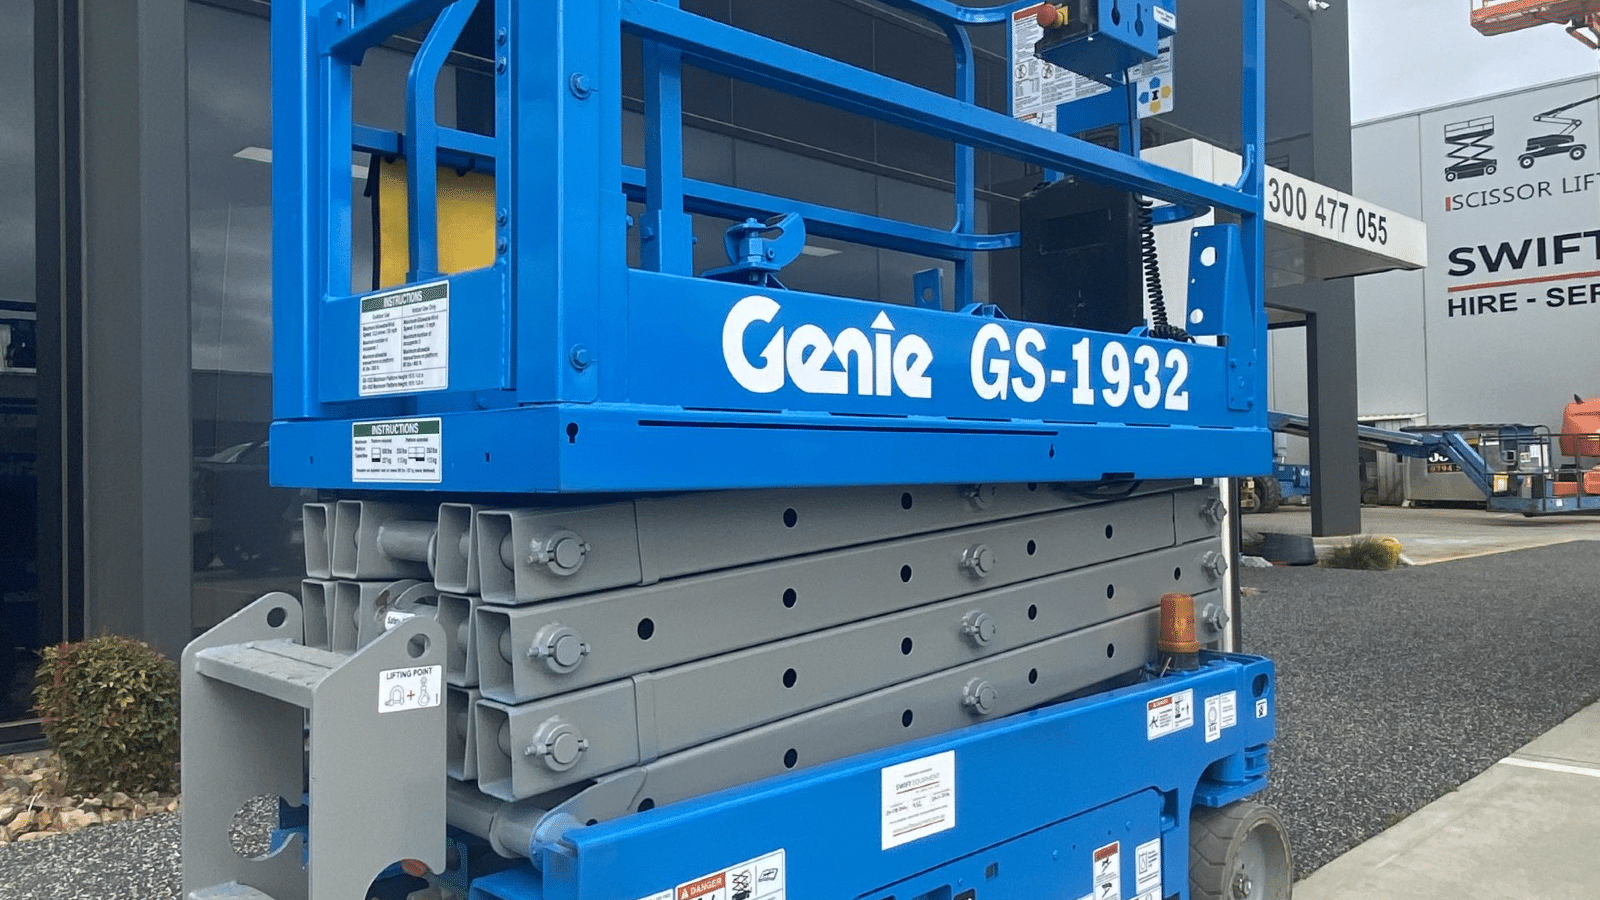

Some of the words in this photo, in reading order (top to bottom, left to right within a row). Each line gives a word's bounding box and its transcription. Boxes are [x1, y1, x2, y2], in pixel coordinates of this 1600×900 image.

[1452, 181, 1552, 211] SCISSOR
[1562, 172, 1600, 194] LIF
[1269, 177, 1307, 221] 300
[1315, 194, 1349, 233] 477
[1357, 207, 1387, 246] 055
[1447, 229, 1600, 277] SWIFT
[383, 290, 423, 308] INSTRUCTIONS
[1448, 292, 1518, 318] HIRE
[722, 295, 934, 399] Genie
[970, 322, 1189, 412] GS-1932
[371, 422, 419, 435] INSTRUCTIONS
[386, 669, 412, 680] LIFTING
[413, 667, 432, 677] POINT
[895, 780, 912, 791] SWIFT
[912, 772, 940, 786] EQUIPMENT
[690, 877, 722, 895] DANGER
